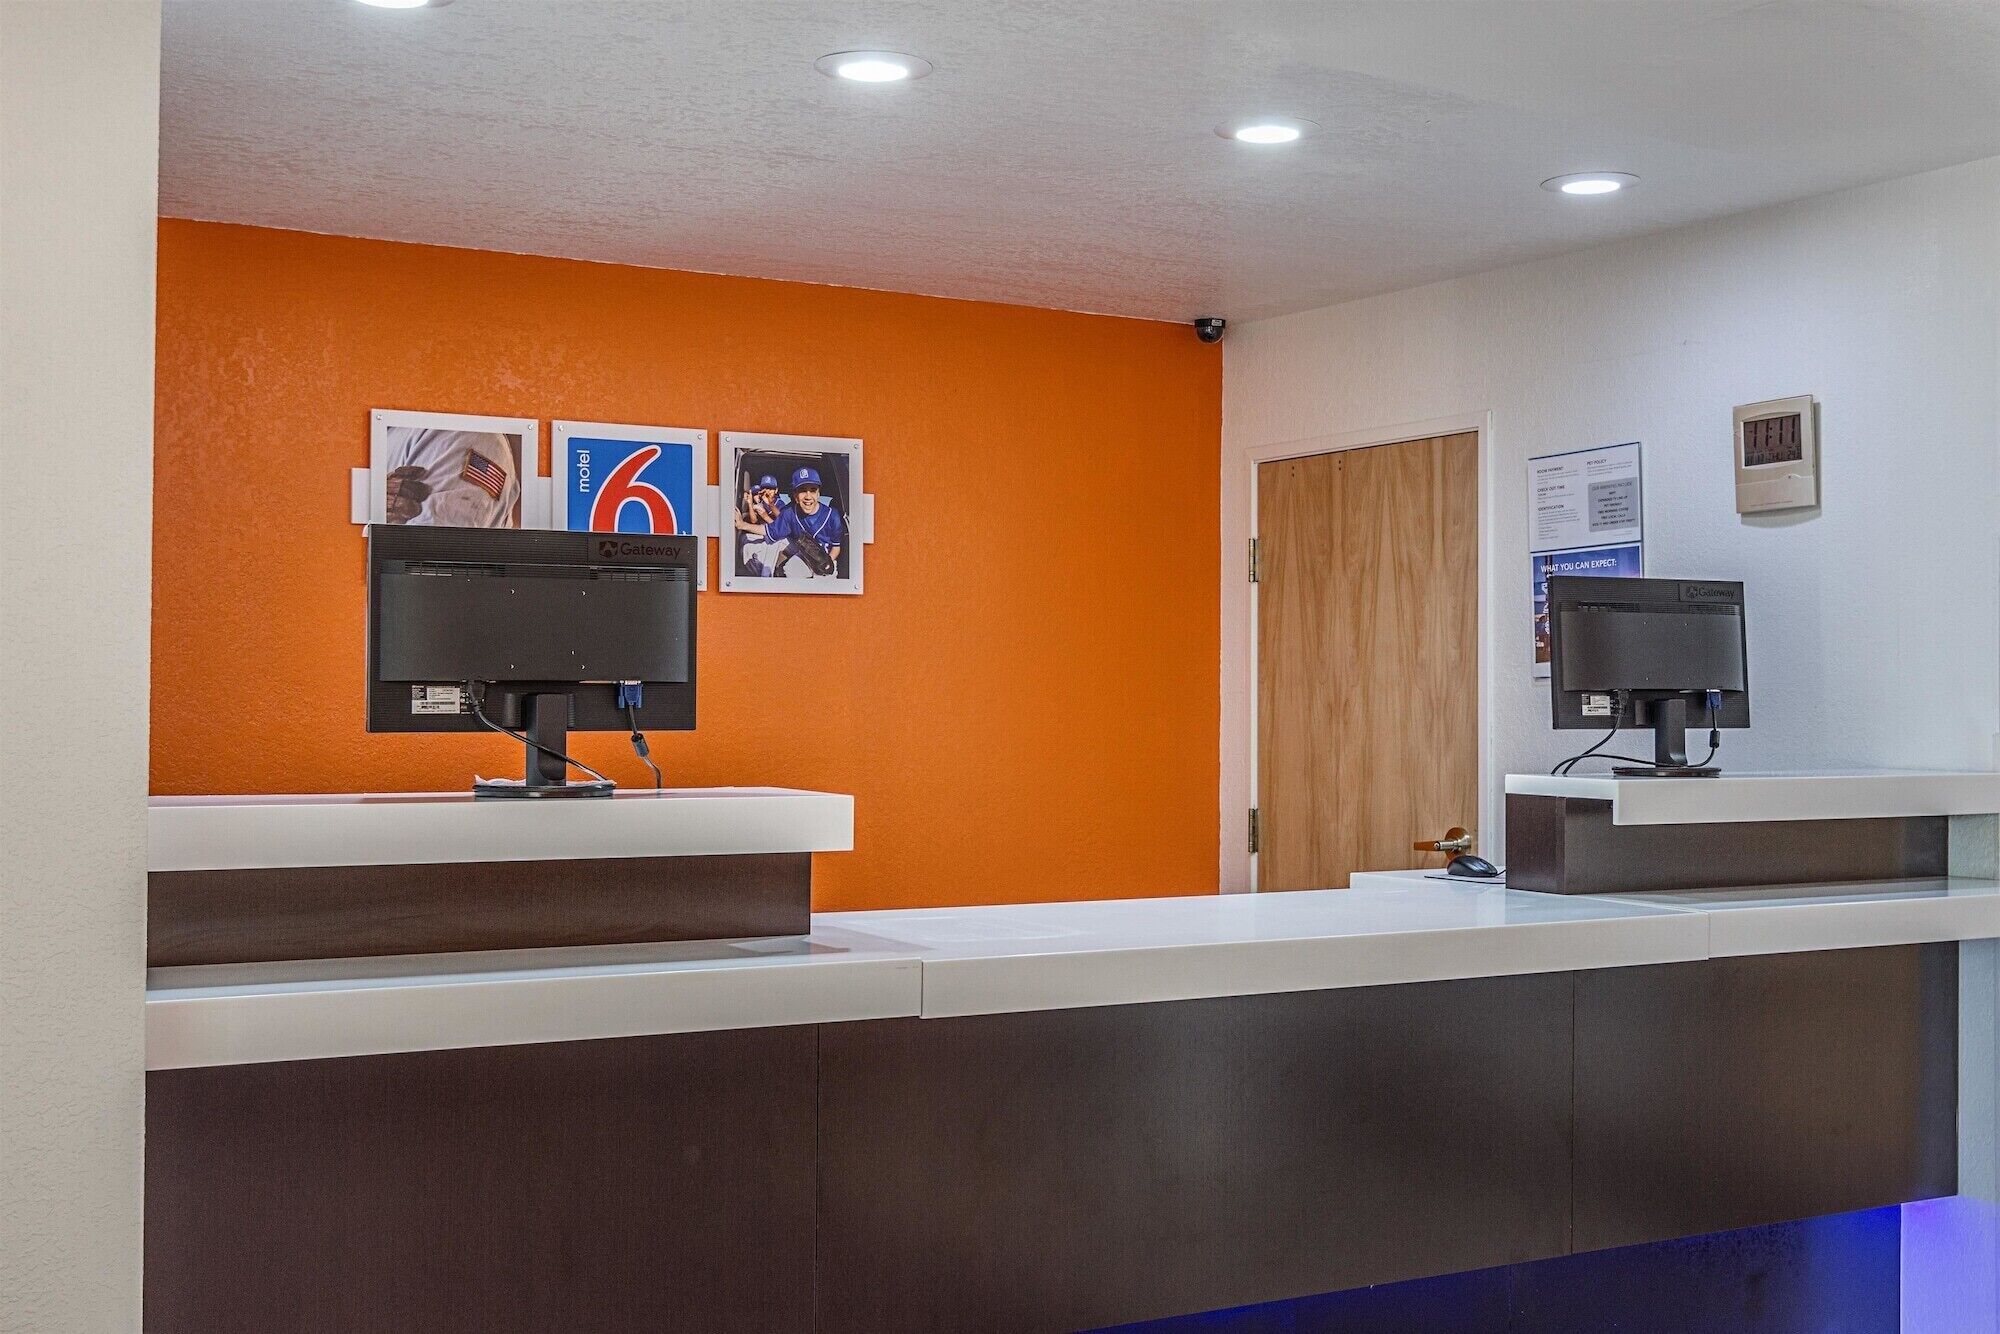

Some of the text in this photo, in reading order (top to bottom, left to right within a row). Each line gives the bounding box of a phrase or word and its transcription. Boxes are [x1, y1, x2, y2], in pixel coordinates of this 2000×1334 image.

[576, 449, 590, 493] motel
[588, 444, 678, 536] 6
[620, 542, 681, 560] Gateway
[1540, 558, 1617, 573] WHAT YOU CAN EXPECT:
[1698, 586, 1735, 600] Gateway
